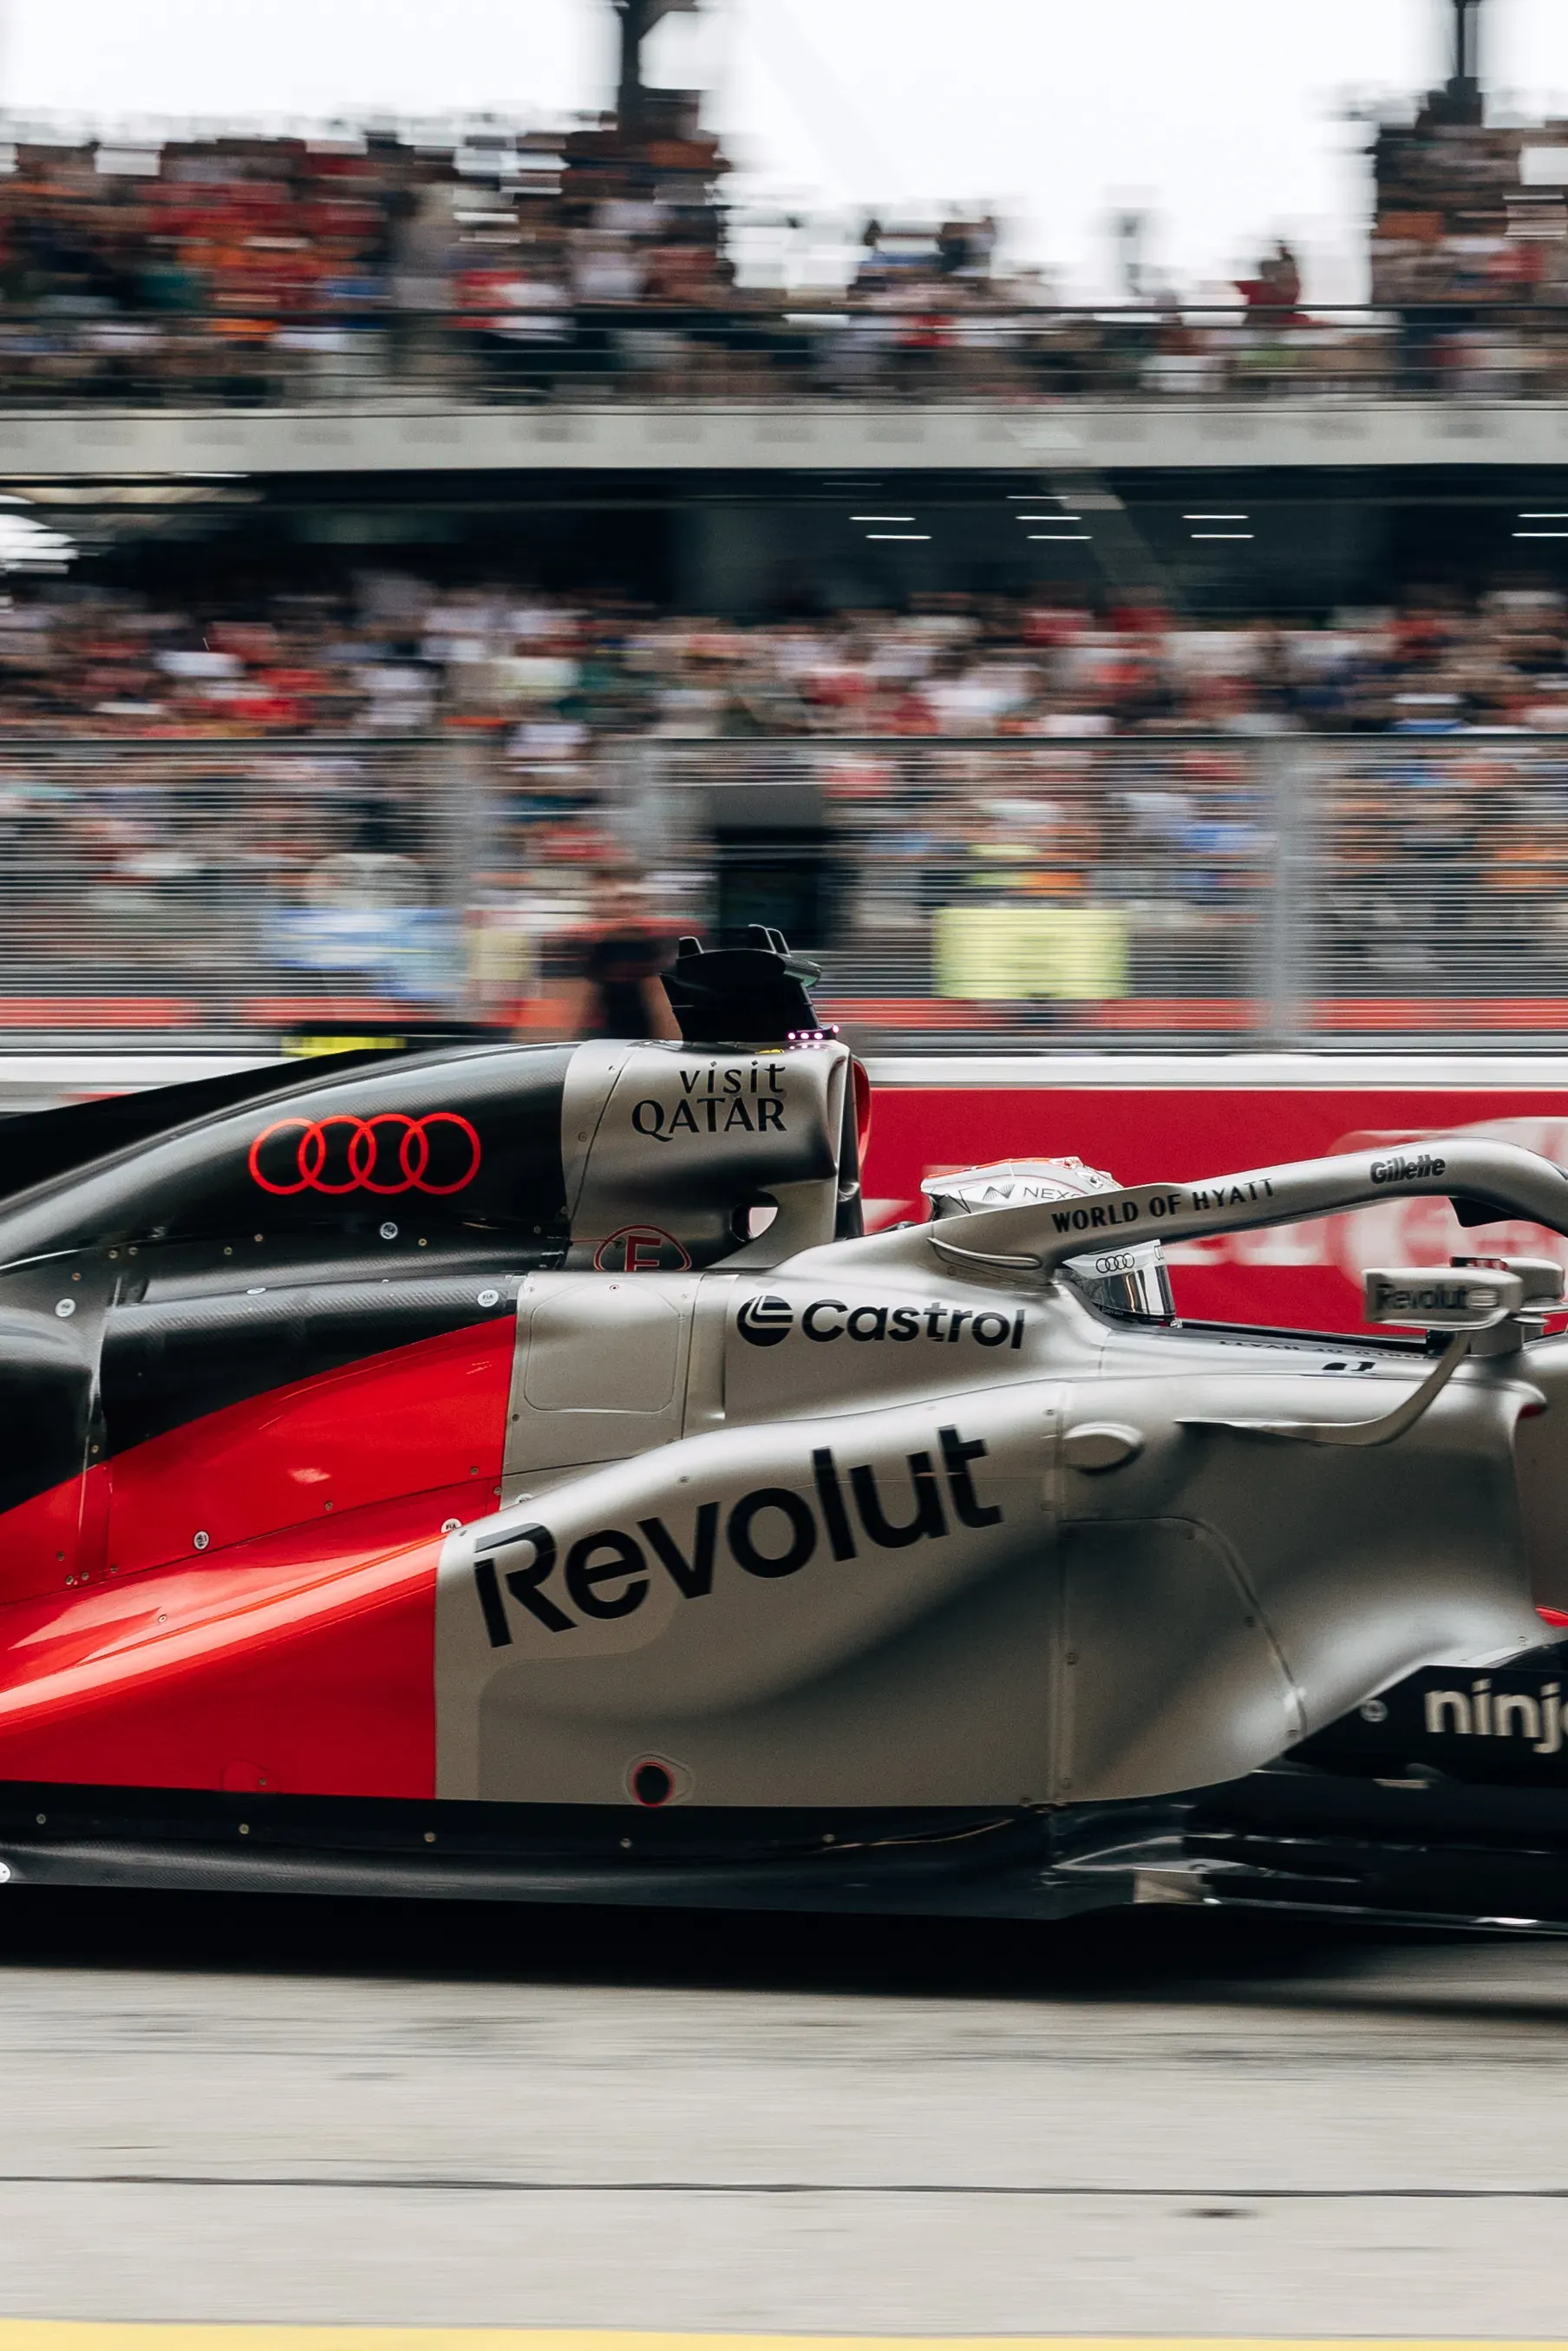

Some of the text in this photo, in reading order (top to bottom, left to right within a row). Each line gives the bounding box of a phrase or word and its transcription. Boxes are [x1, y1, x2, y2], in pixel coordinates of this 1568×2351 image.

[679, 1060, 786, 1094] visit
[631, 1097, 787, 1143] QATAR
[1370, 1155, 1446, 1184] Gillette
[1051, 1178, 1274, 1233] WORLD OF HYATT
[802, 1299, 1026, 1349] Castrol
[474, 1424, 1003, 1647] Revolut
[1424, 1678, 1568, 1753] ninj
